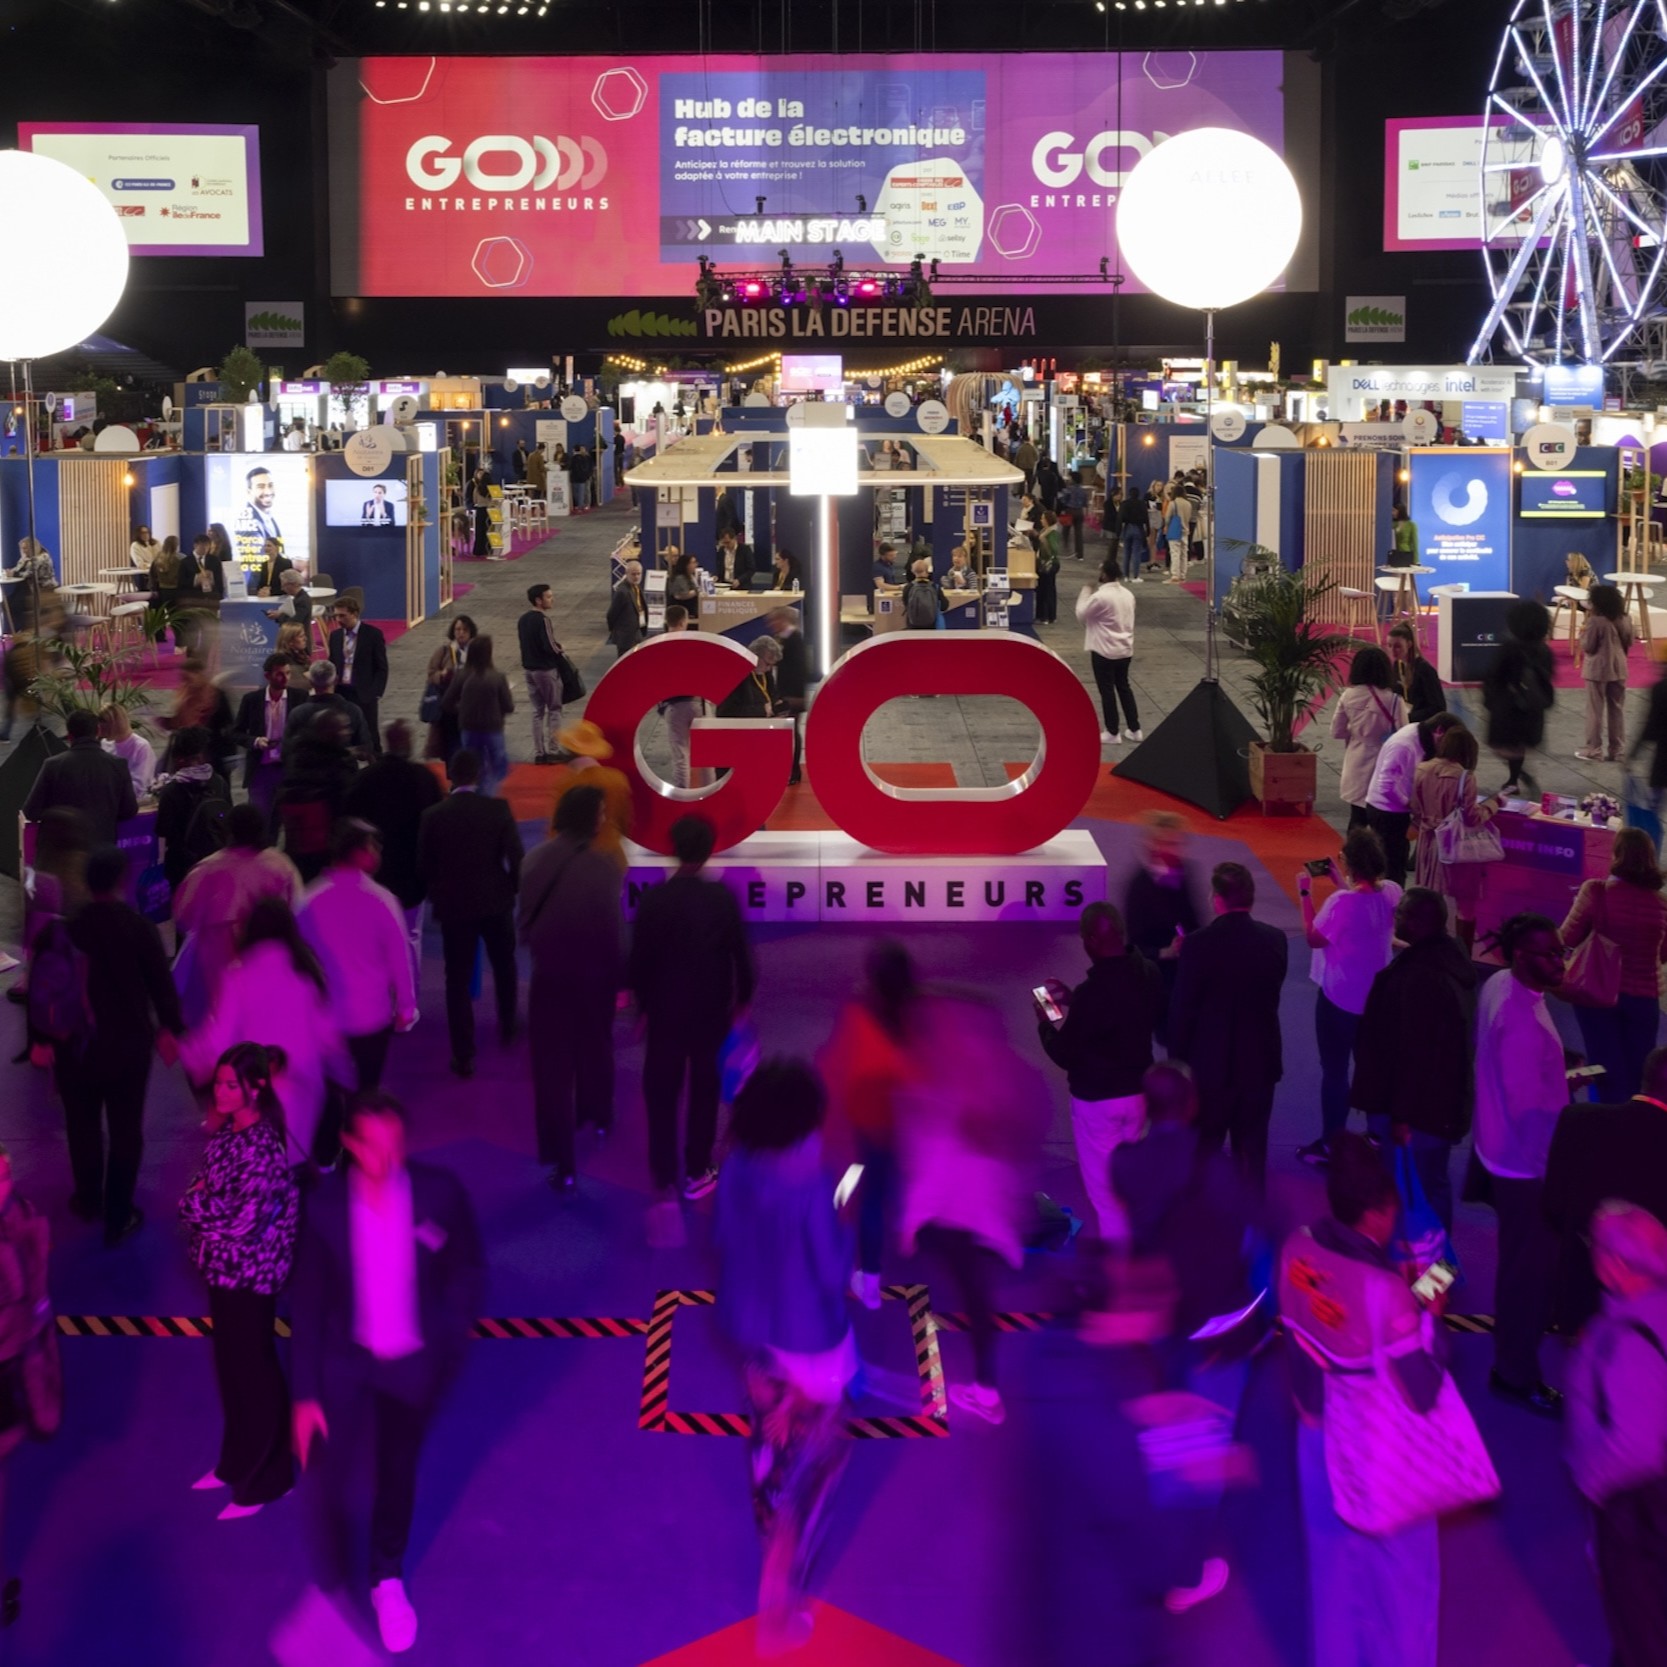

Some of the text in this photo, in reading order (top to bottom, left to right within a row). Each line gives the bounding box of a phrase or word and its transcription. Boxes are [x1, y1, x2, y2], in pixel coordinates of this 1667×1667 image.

[674, 98, 805, 118] Hub de la
[674, 124, 966, 148] facture électronique
[675, 158, 866, 171] Anticipez la réforme et trouvez la solution
[675, 171, 714, 182] adaptée
[715, 171, 723, 180] à
[724, 171, 749, 180] votre
[750, 171, 797, 182] entreprise
[172, 204, 198, 213] Région
[405, 197, 609, 210] ENTREPRENEURS
[1031, 194, 1118, 208] ENTREP
[735, 218, 886, 243] MAIN STAGE
[705, 307, 1036, 338] PARIS LA DEFENSE ARENA
[1352, 379, 1379, 390] DELL
[586, 630, 1101, 856] GO
[1500, 837, 1575, 858] OINT INFO
